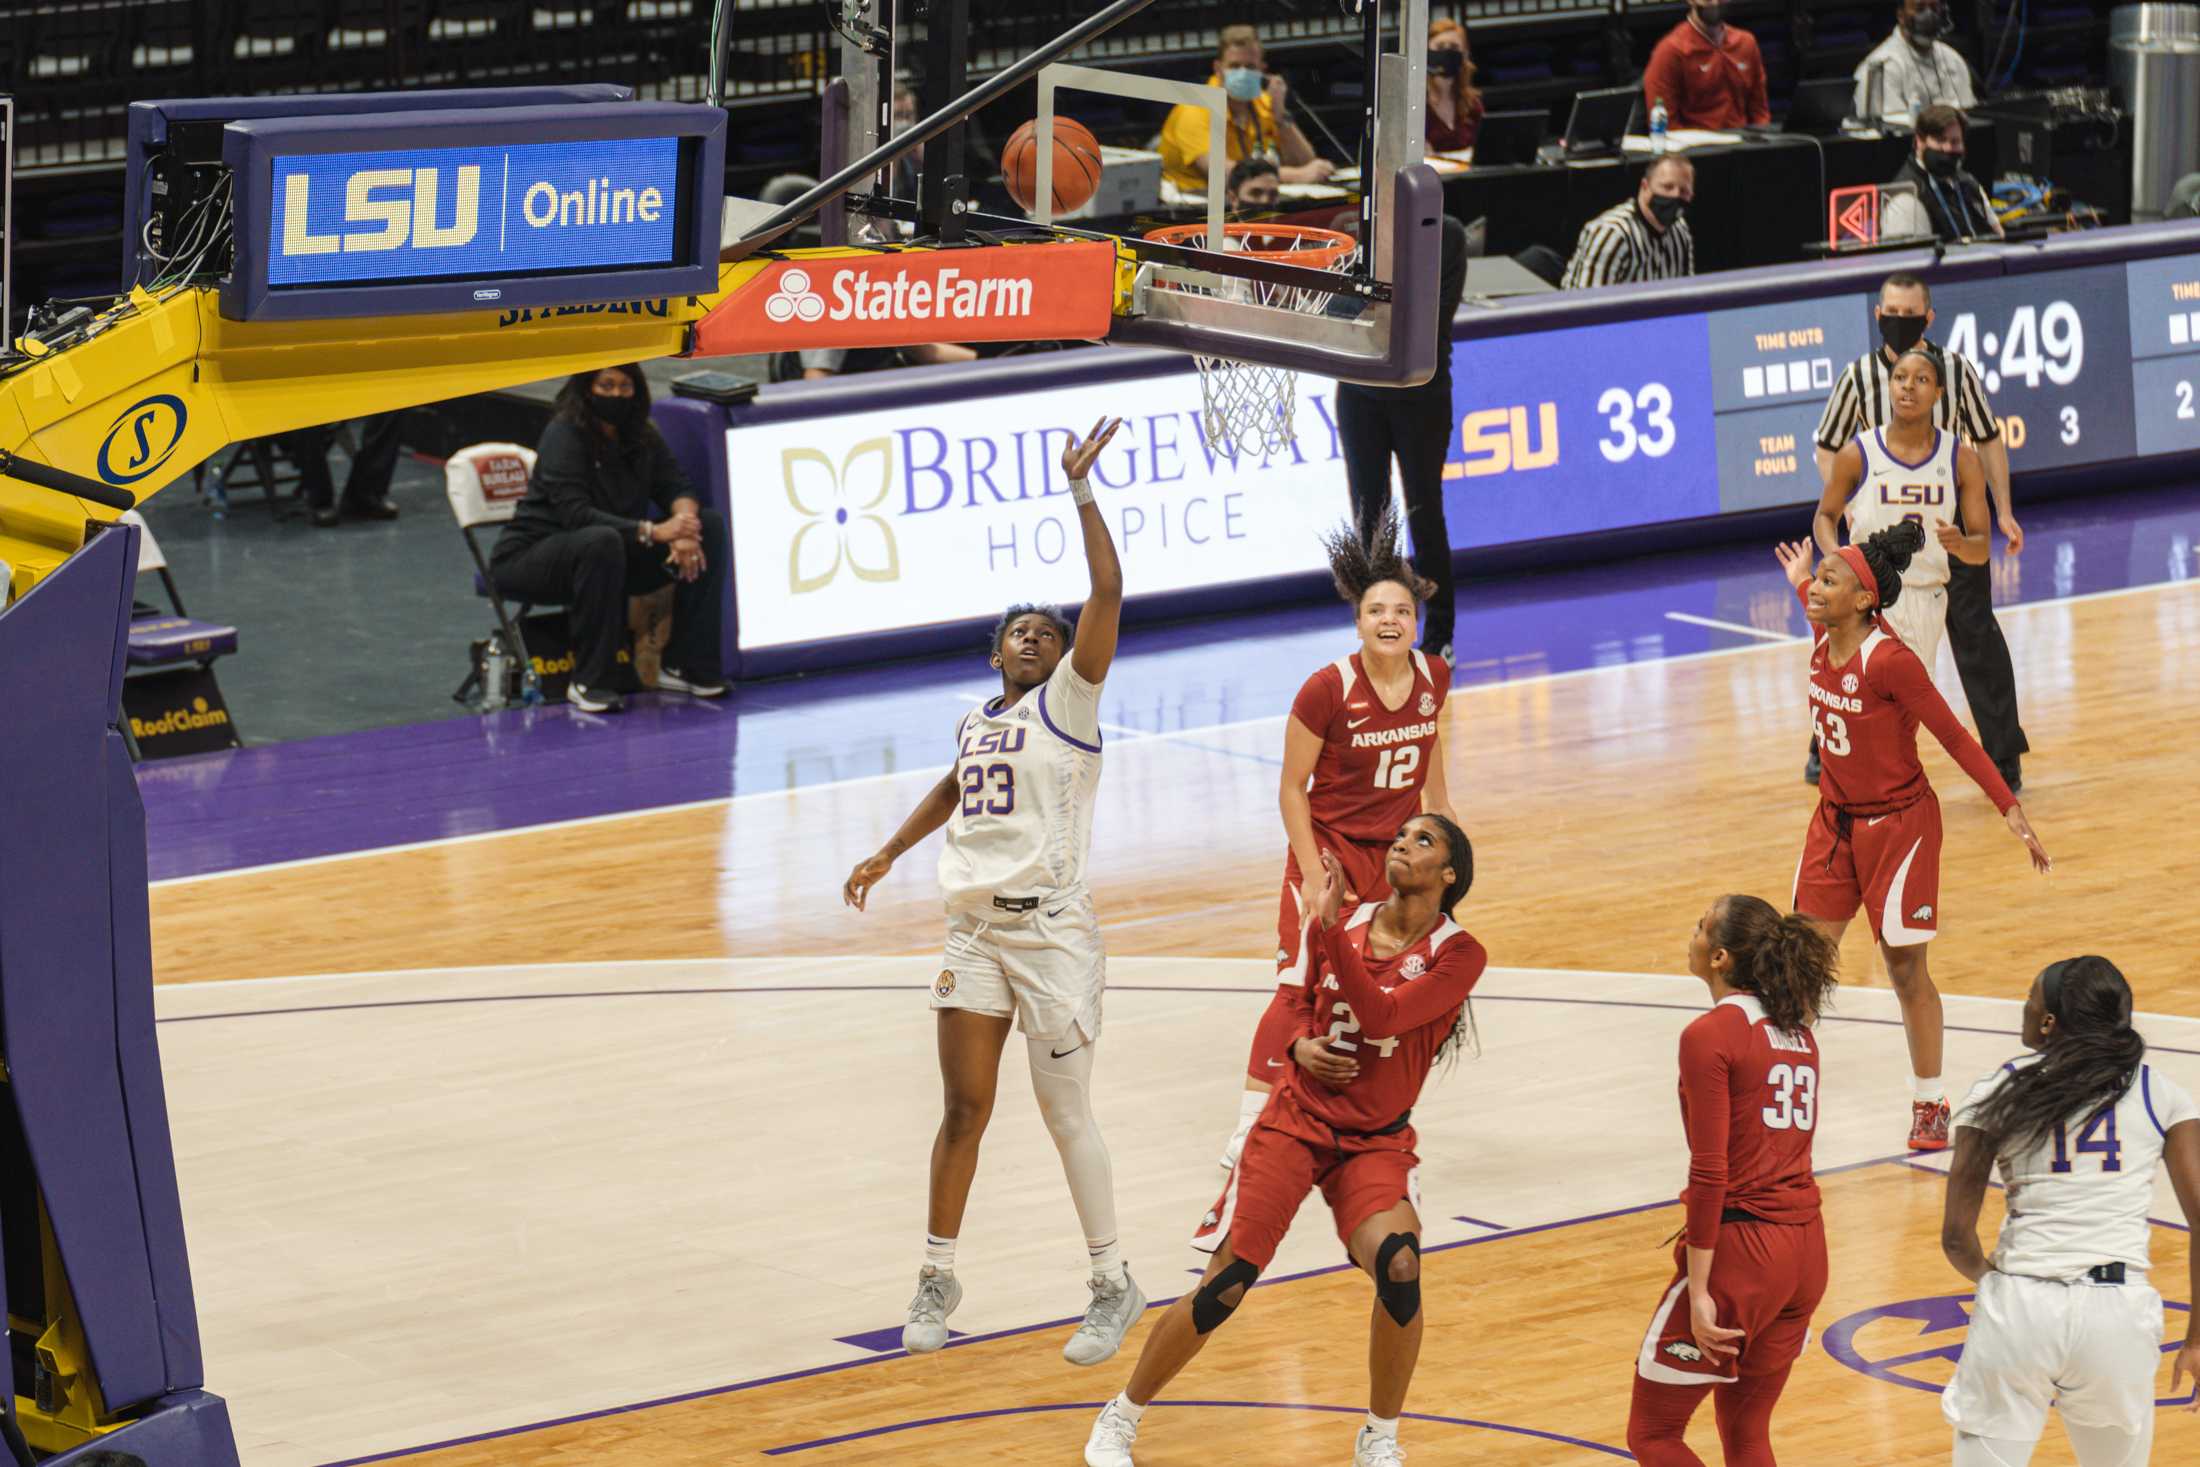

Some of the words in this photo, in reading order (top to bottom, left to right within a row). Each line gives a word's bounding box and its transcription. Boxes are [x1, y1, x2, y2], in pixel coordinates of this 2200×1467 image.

[282, 165, 481, 256] LSU
[523, 177, 663, 228] Online
[1755, 332, 1787, 351] TIME
[1789, 328, 1825, 347] OUTS
[1947, 300, 2084, 393] 4:49
[2176, 380, 2195, 419] 2
[1597, 383, 1676, 463] 33
[2060, 406, 2080, 445] 3
[1759, 435, 1795, 453] TEAM
[1755, 455, 1797, 476] FOULS
[1880, 484, 1944, 505] LSU
[988, 493, 1247, 571] HOPICE
[129, 699, 228, 738] RoofClaim
[1351, 720, 1436, 747] ARKANSAS
[1812, 704, 1851, 757] 43
[960, 728, 1027, 759] LSU
[1374, 745, 1420, 789] 12
[962, 763, 1015, 817] 23
[1762, 1063, 1817, 1131] 33
[2050, 1100, 2122, 1173] 14
